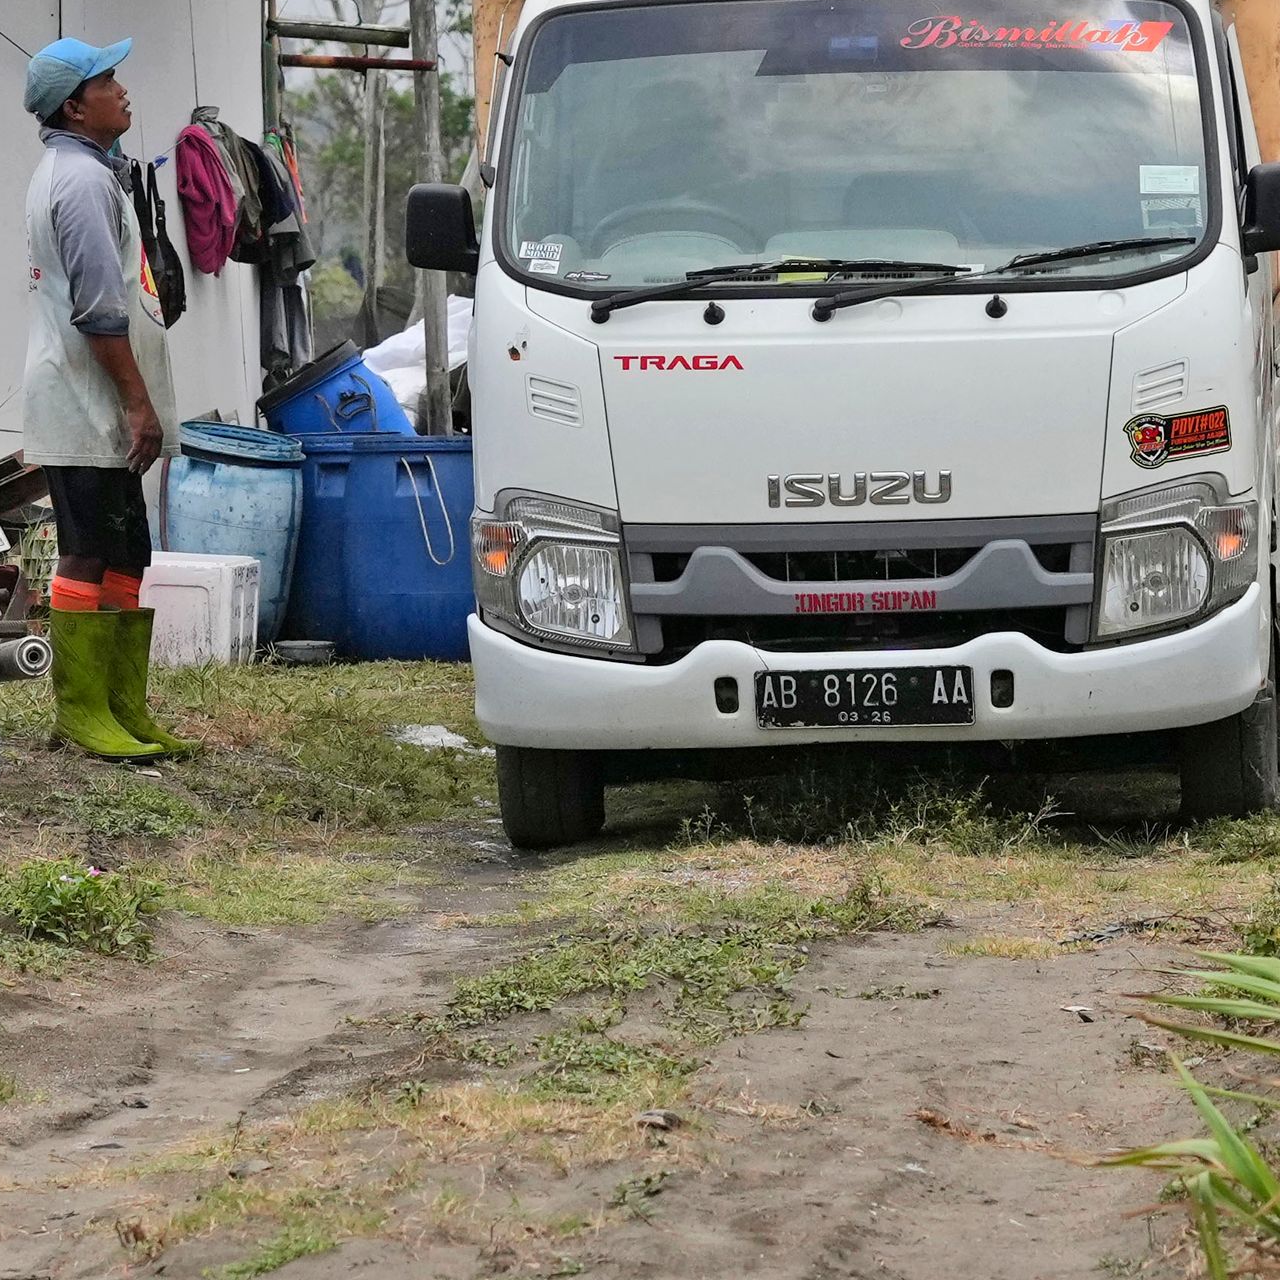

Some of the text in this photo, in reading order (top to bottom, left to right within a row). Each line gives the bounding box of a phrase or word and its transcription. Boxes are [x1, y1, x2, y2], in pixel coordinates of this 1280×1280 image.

[900, 15, 1147, 51] Bismillah
[614, 355, 744, 370] TRAGA
[767, 470, 952, 508] ISUZU
[872, 590, 937, 611] SOPAN
[762, 670, 969, 709] AB 8126 AA
